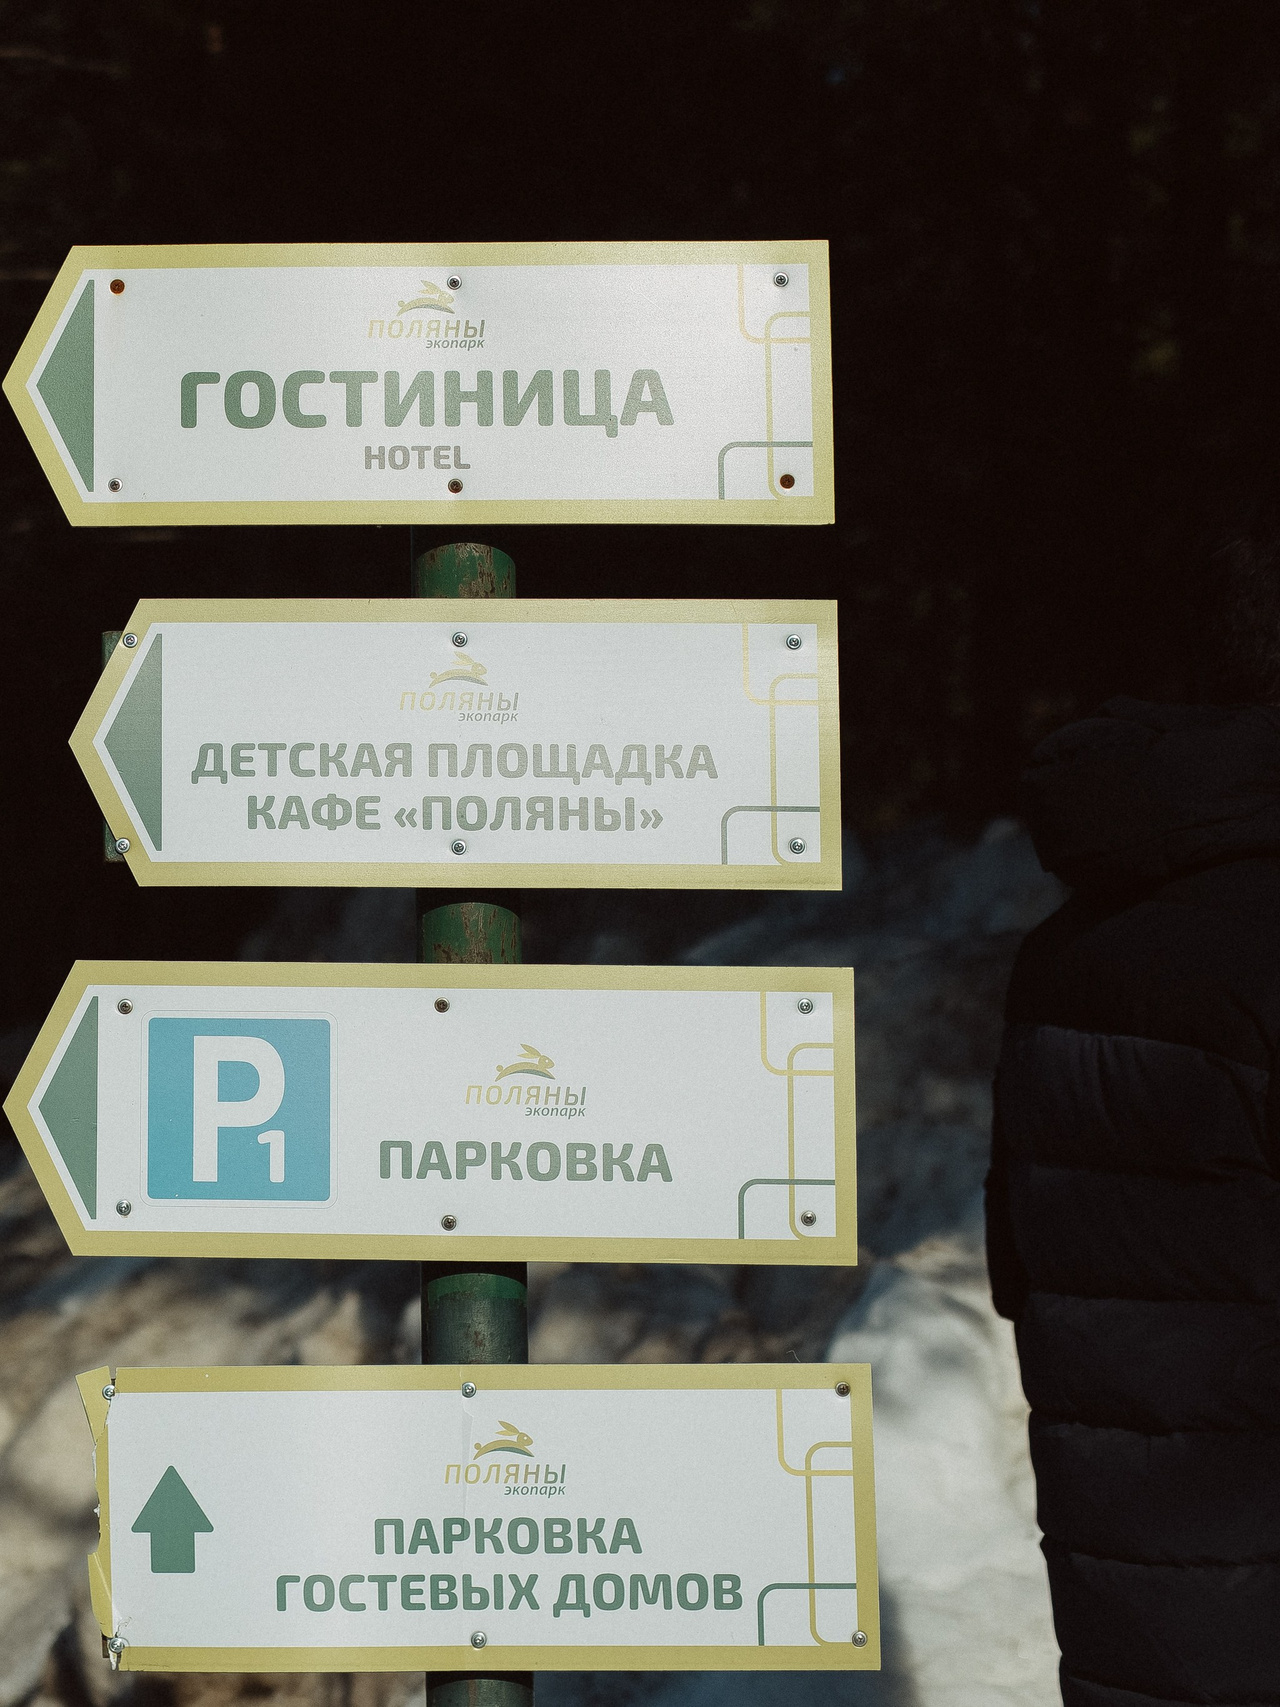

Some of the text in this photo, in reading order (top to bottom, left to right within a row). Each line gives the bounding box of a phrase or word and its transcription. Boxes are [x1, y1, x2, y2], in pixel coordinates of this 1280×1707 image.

[368, 318, 486, 341] ПОЛЯНЫ
[425, 337, 485, 351] экопарк
[180, 369, 675, 438] ГОСТИНИЦА
[364, 445, 471, 470] HOTEL
[400, 691, 519, 712] ПОЛЯНЫ
[457, 711, 519, 725] экопарк
[191, 742, 718, 785] ДЕТСКАЯ ПЛОЩАДКА
[247, 795, 664, 832] КАФЕ «ПОЛЯНЫ»
[465, 1083, 587, 1107] ПОЛЯНЫ
[524, 1106, 586, 1120] экопарк
[379, 1140, 673, 1183] ПАРКОВКА
[445, 1463, 566, 1485] ПОЛЯНЫ
[504, 1484, 566, 1498] экопарк
[374, 1517, 642, 1555] ПАРКОВКА
[275, 1574, 743, 1618] ГОСТЕВЫХ ДОМОВ
